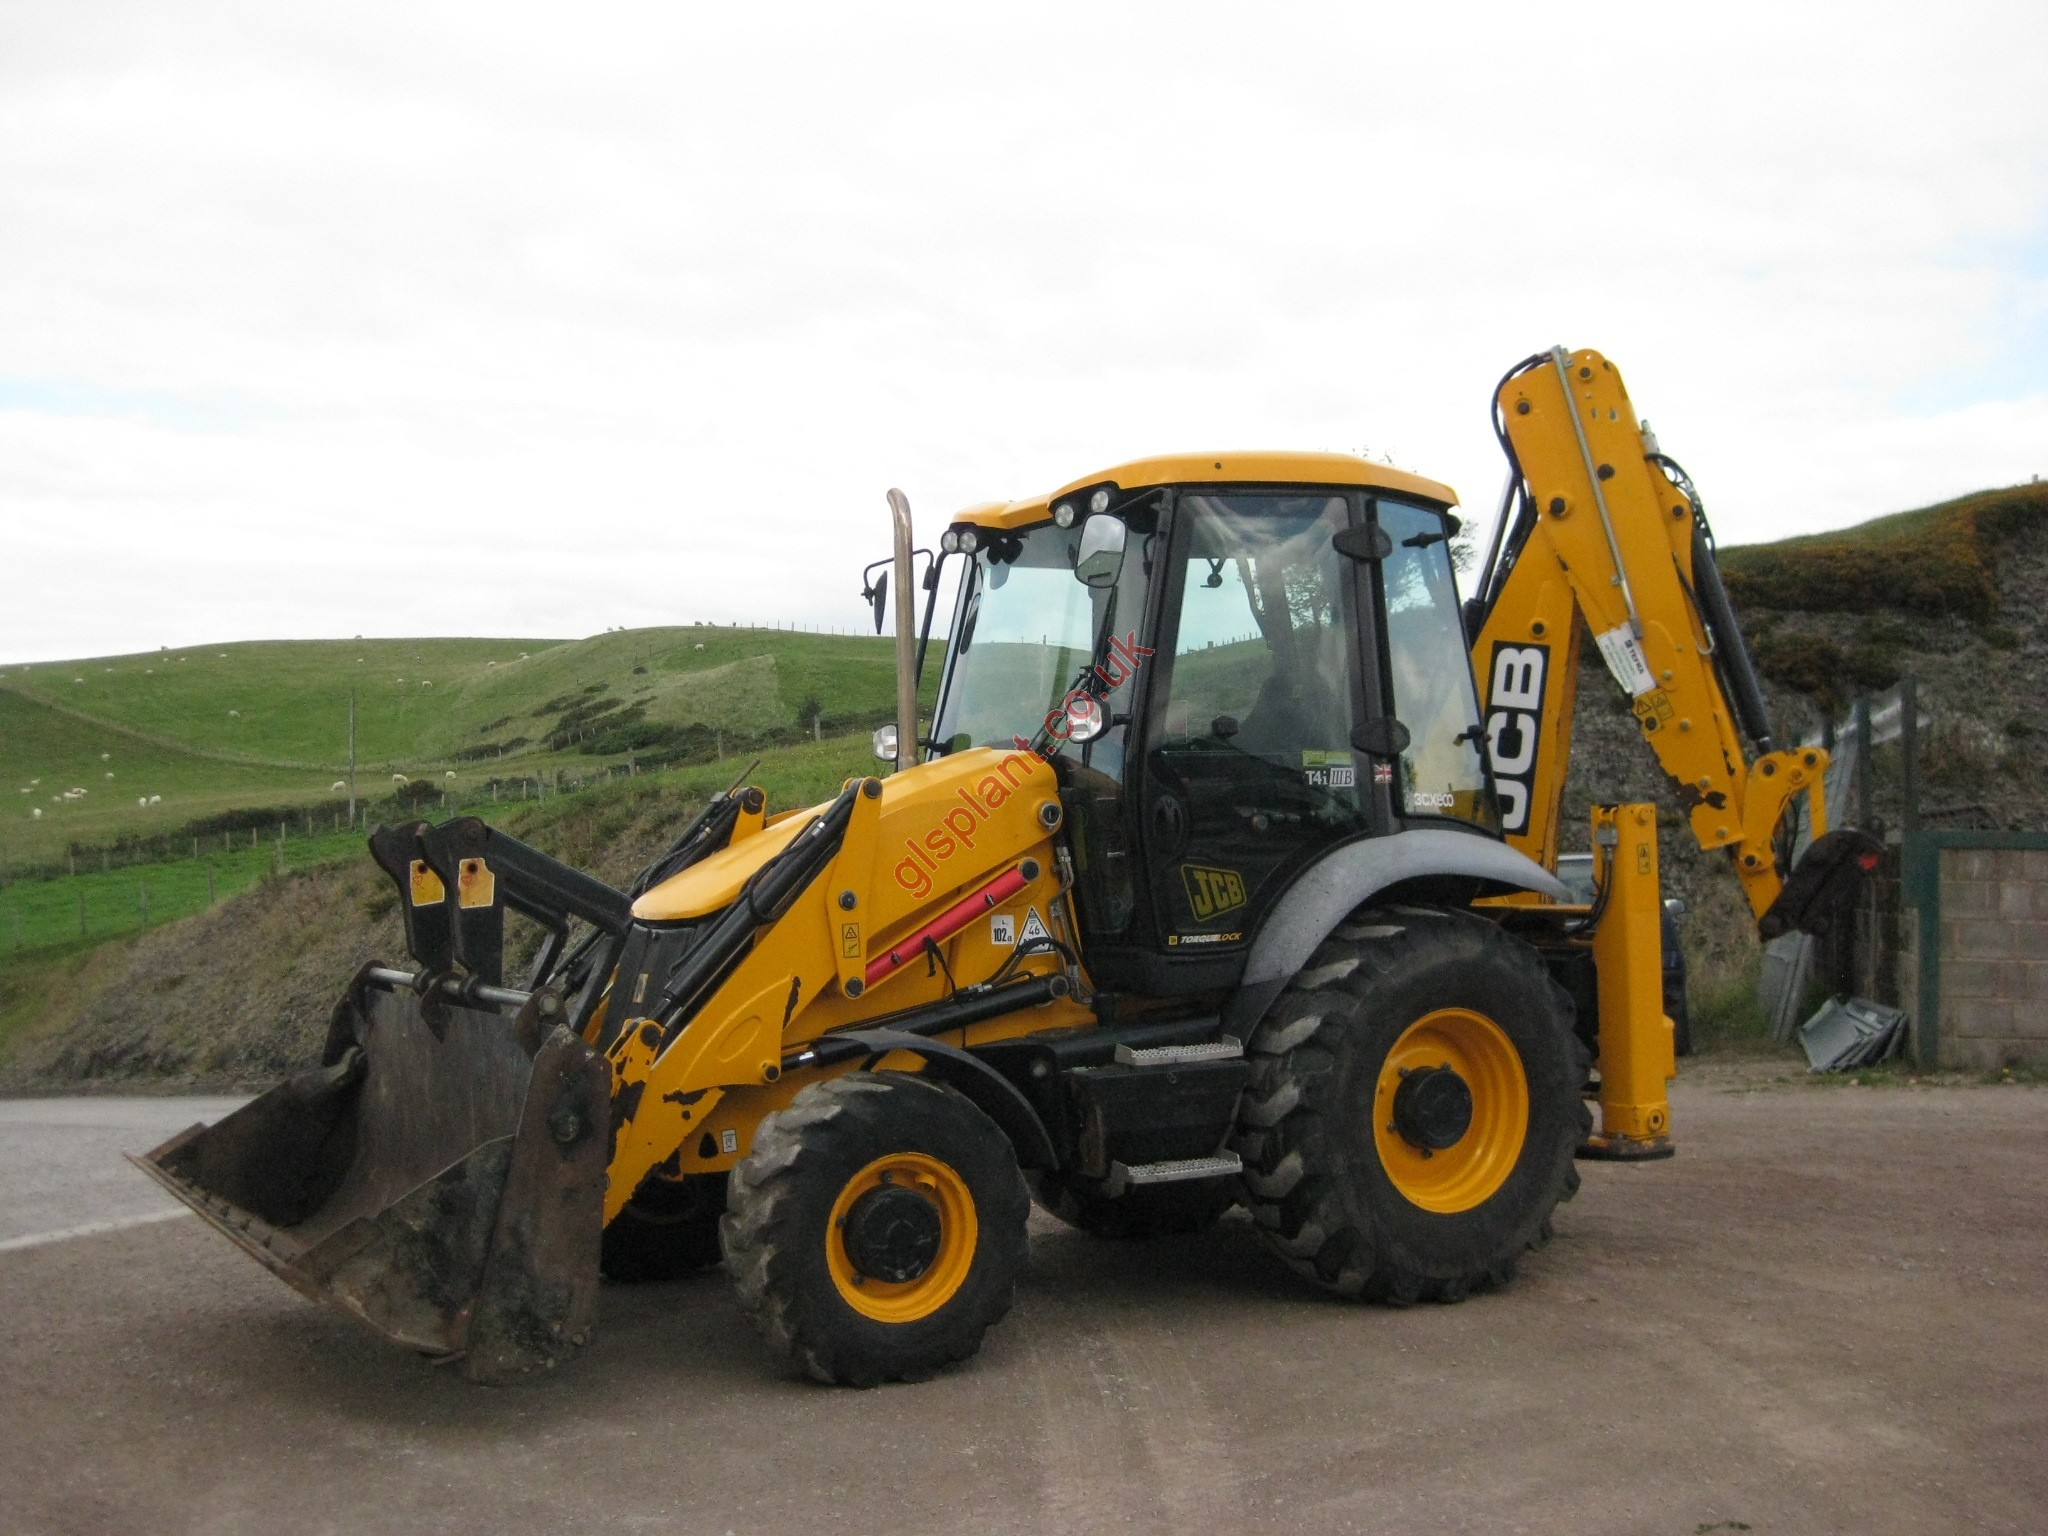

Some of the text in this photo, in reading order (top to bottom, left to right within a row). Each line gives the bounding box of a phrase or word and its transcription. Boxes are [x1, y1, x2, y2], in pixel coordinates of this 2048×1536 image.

[1487, 648, 1544, 830] JCB
[1305, 770, 1328, 786] T4i
[1192, 869, 1243, 916] JCB
[993, 927, 1007, 942] 102
[1028, 925, 1040, 936] 46
